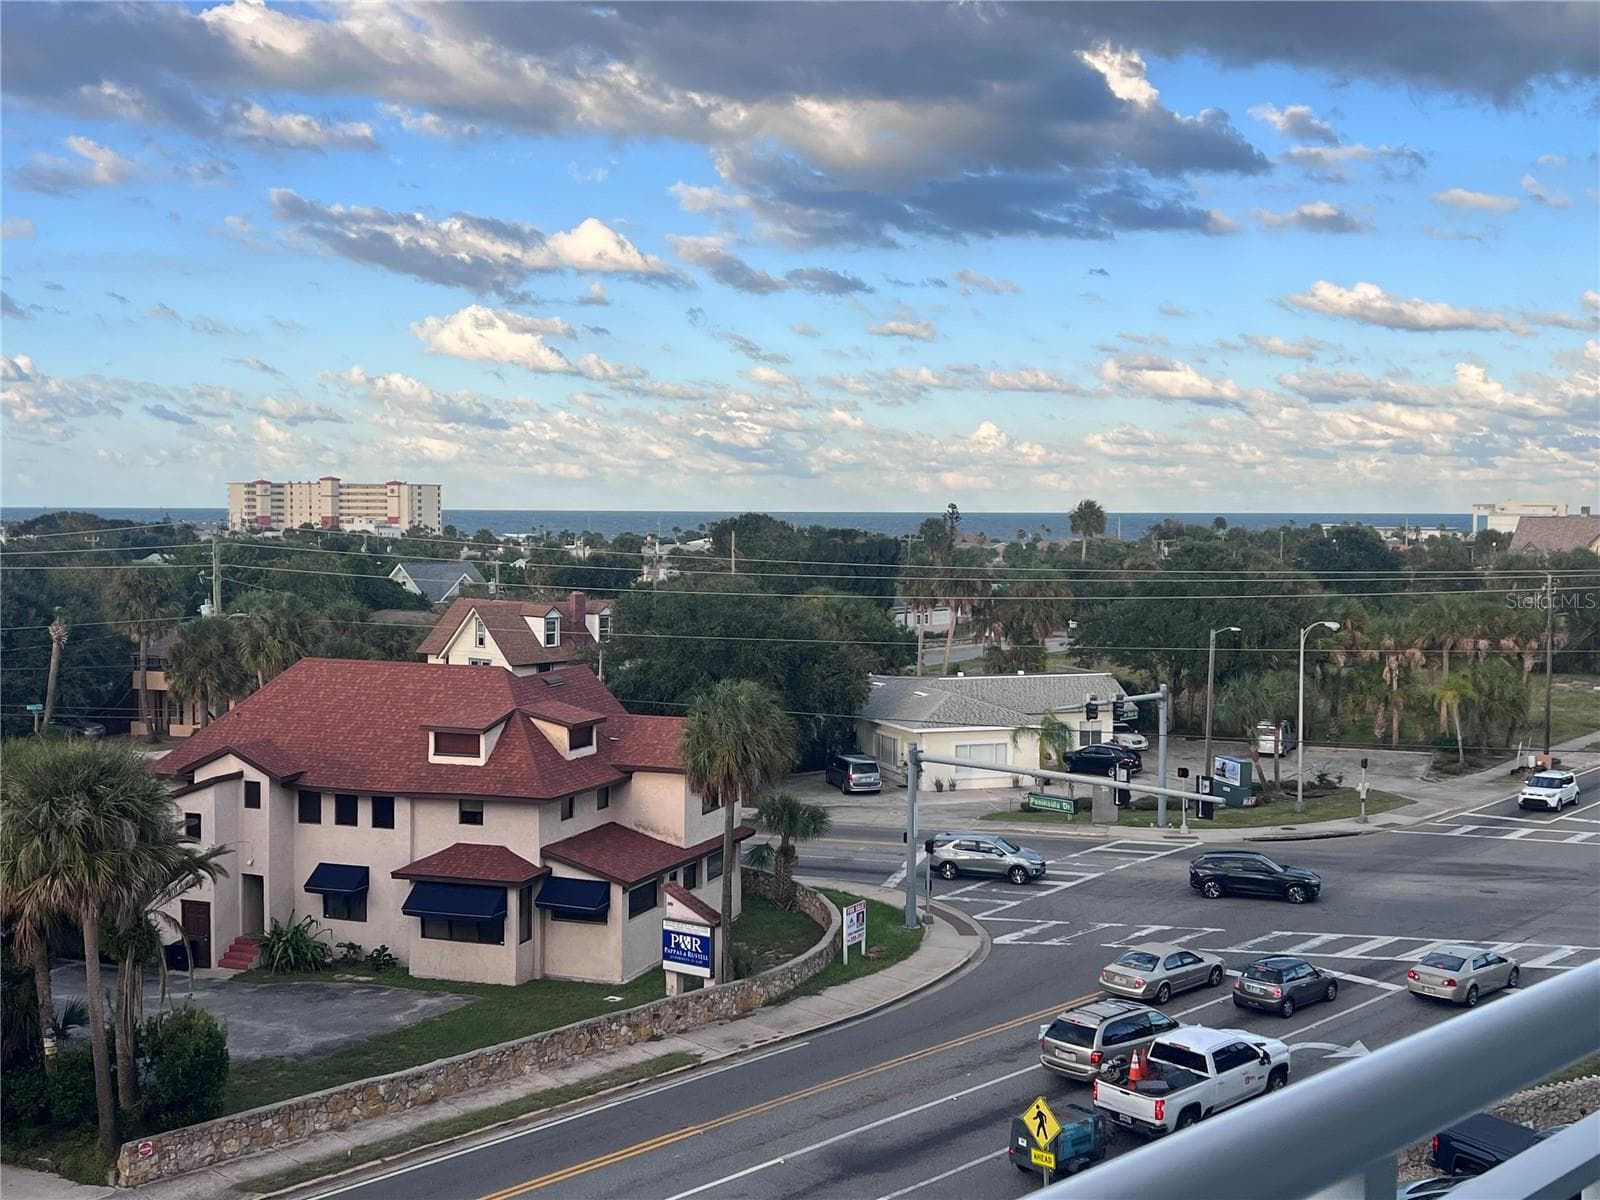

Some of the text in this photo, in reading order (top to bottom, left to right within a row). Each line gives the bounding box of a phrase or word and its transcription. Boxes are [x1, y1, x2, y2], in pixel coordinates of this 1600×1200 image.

[1030, 796, 1071, 811] Peninsula Dr
[670, 933, 702, 953] P&R
[1033, 1153, 1053, 1164] AHEAD
